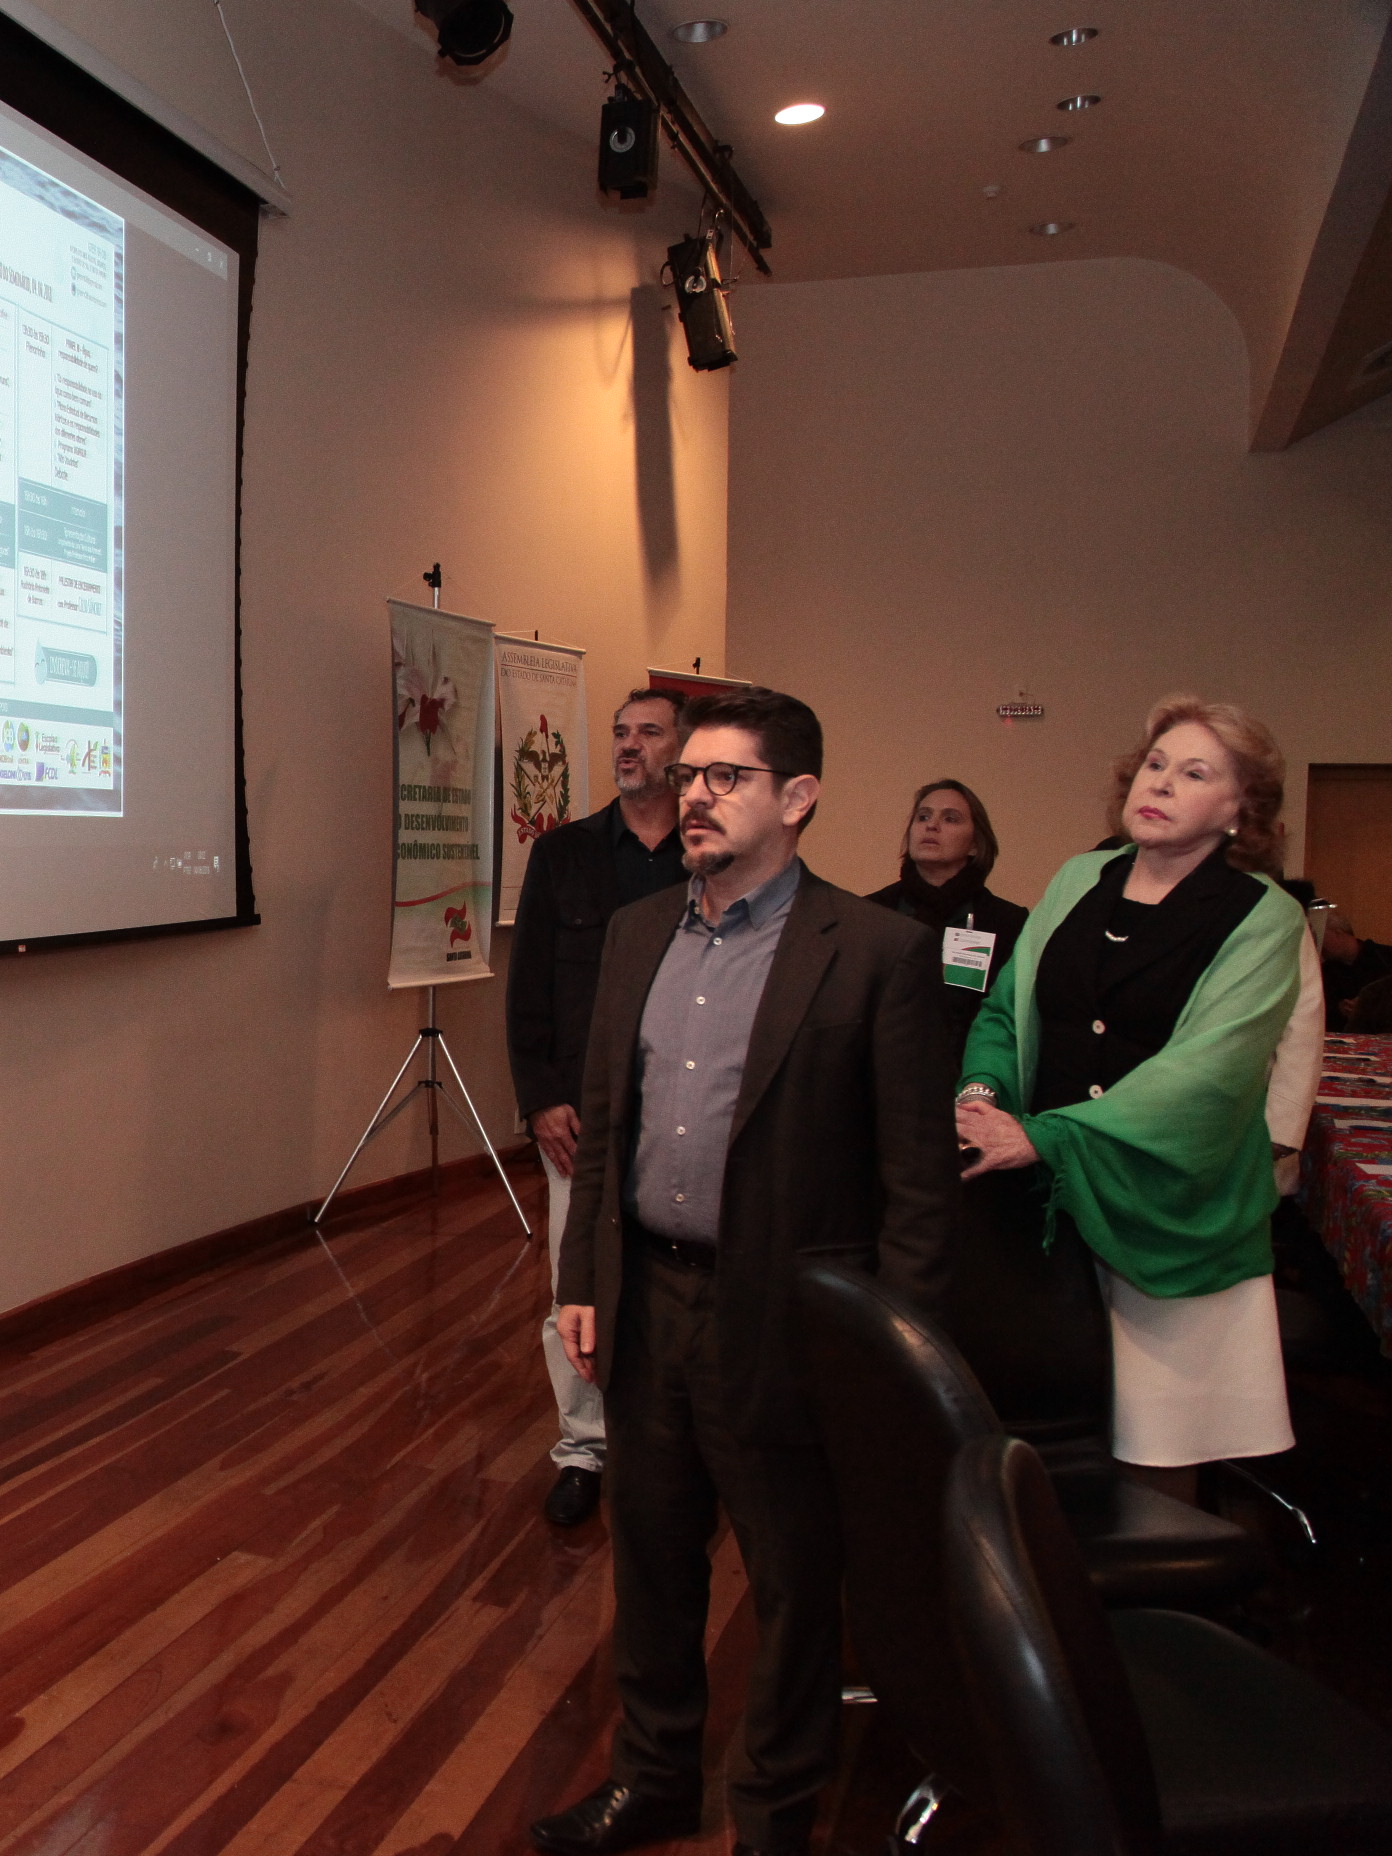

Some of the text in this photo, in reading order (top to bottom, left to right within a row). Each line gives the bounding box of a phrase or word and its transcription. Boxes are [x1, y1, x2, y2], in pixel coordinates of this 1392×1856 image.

[501, 651, 578, 674] ASSEMBLEIA LEGISLATIVA
[511, 668, 531, 680] ESTADO
[539, 672, 556, 684] SANTA
[399, 783, 443, 803] CRETARIA
[404, 813, 469, 833] DESENVOLVIMENTO
